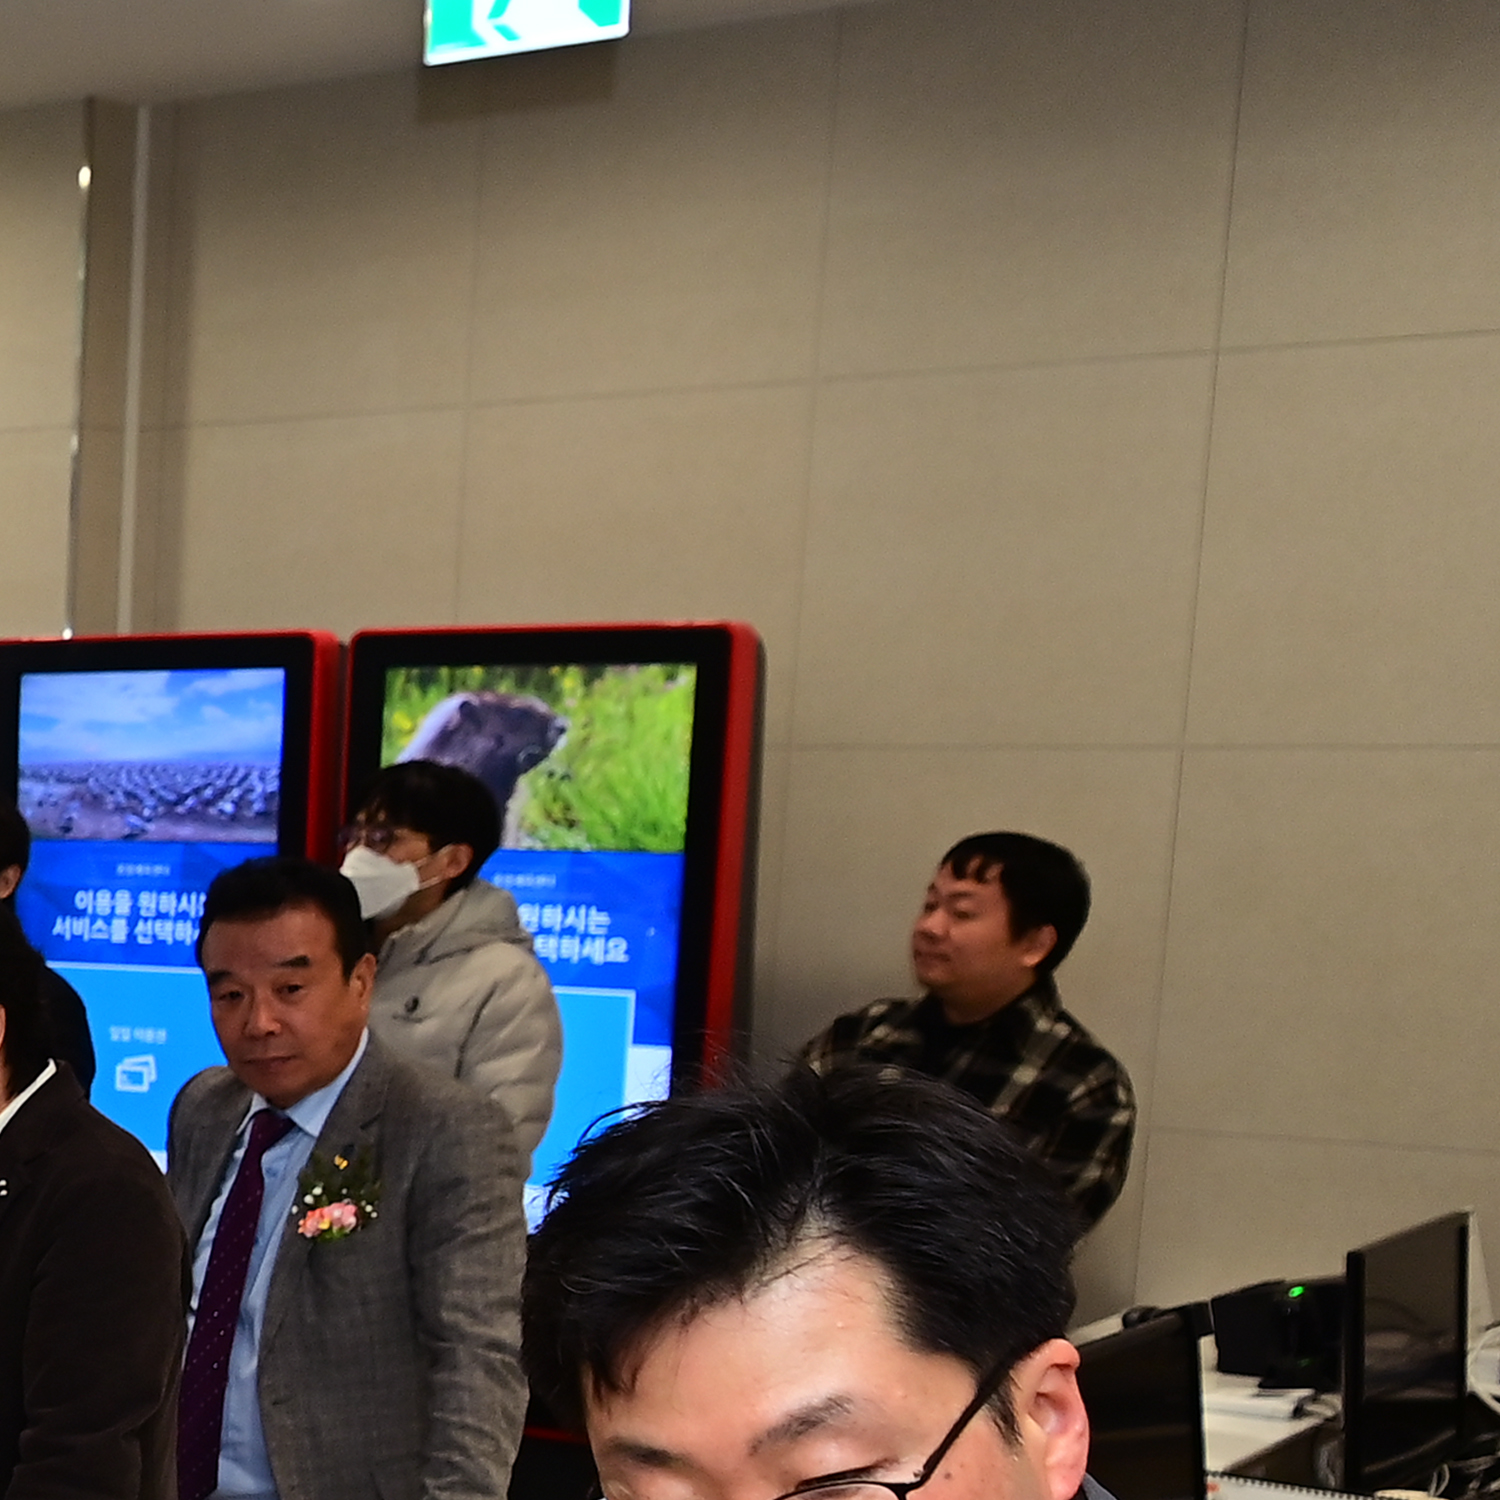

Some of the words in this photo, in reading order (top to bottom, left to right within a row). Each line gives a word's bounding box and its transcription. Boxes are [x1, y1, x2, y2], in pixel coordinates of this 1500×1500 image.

[74, 888, 133, 917] 이용을
[138, 890, 207, 919] 원하시
[517, 901, 611, 935] 원하시는
[52, 914, 129, 944] 서비스를
[134, 918, 200, 946] 선택하
[533, 934, 630, 965] 택하세요
